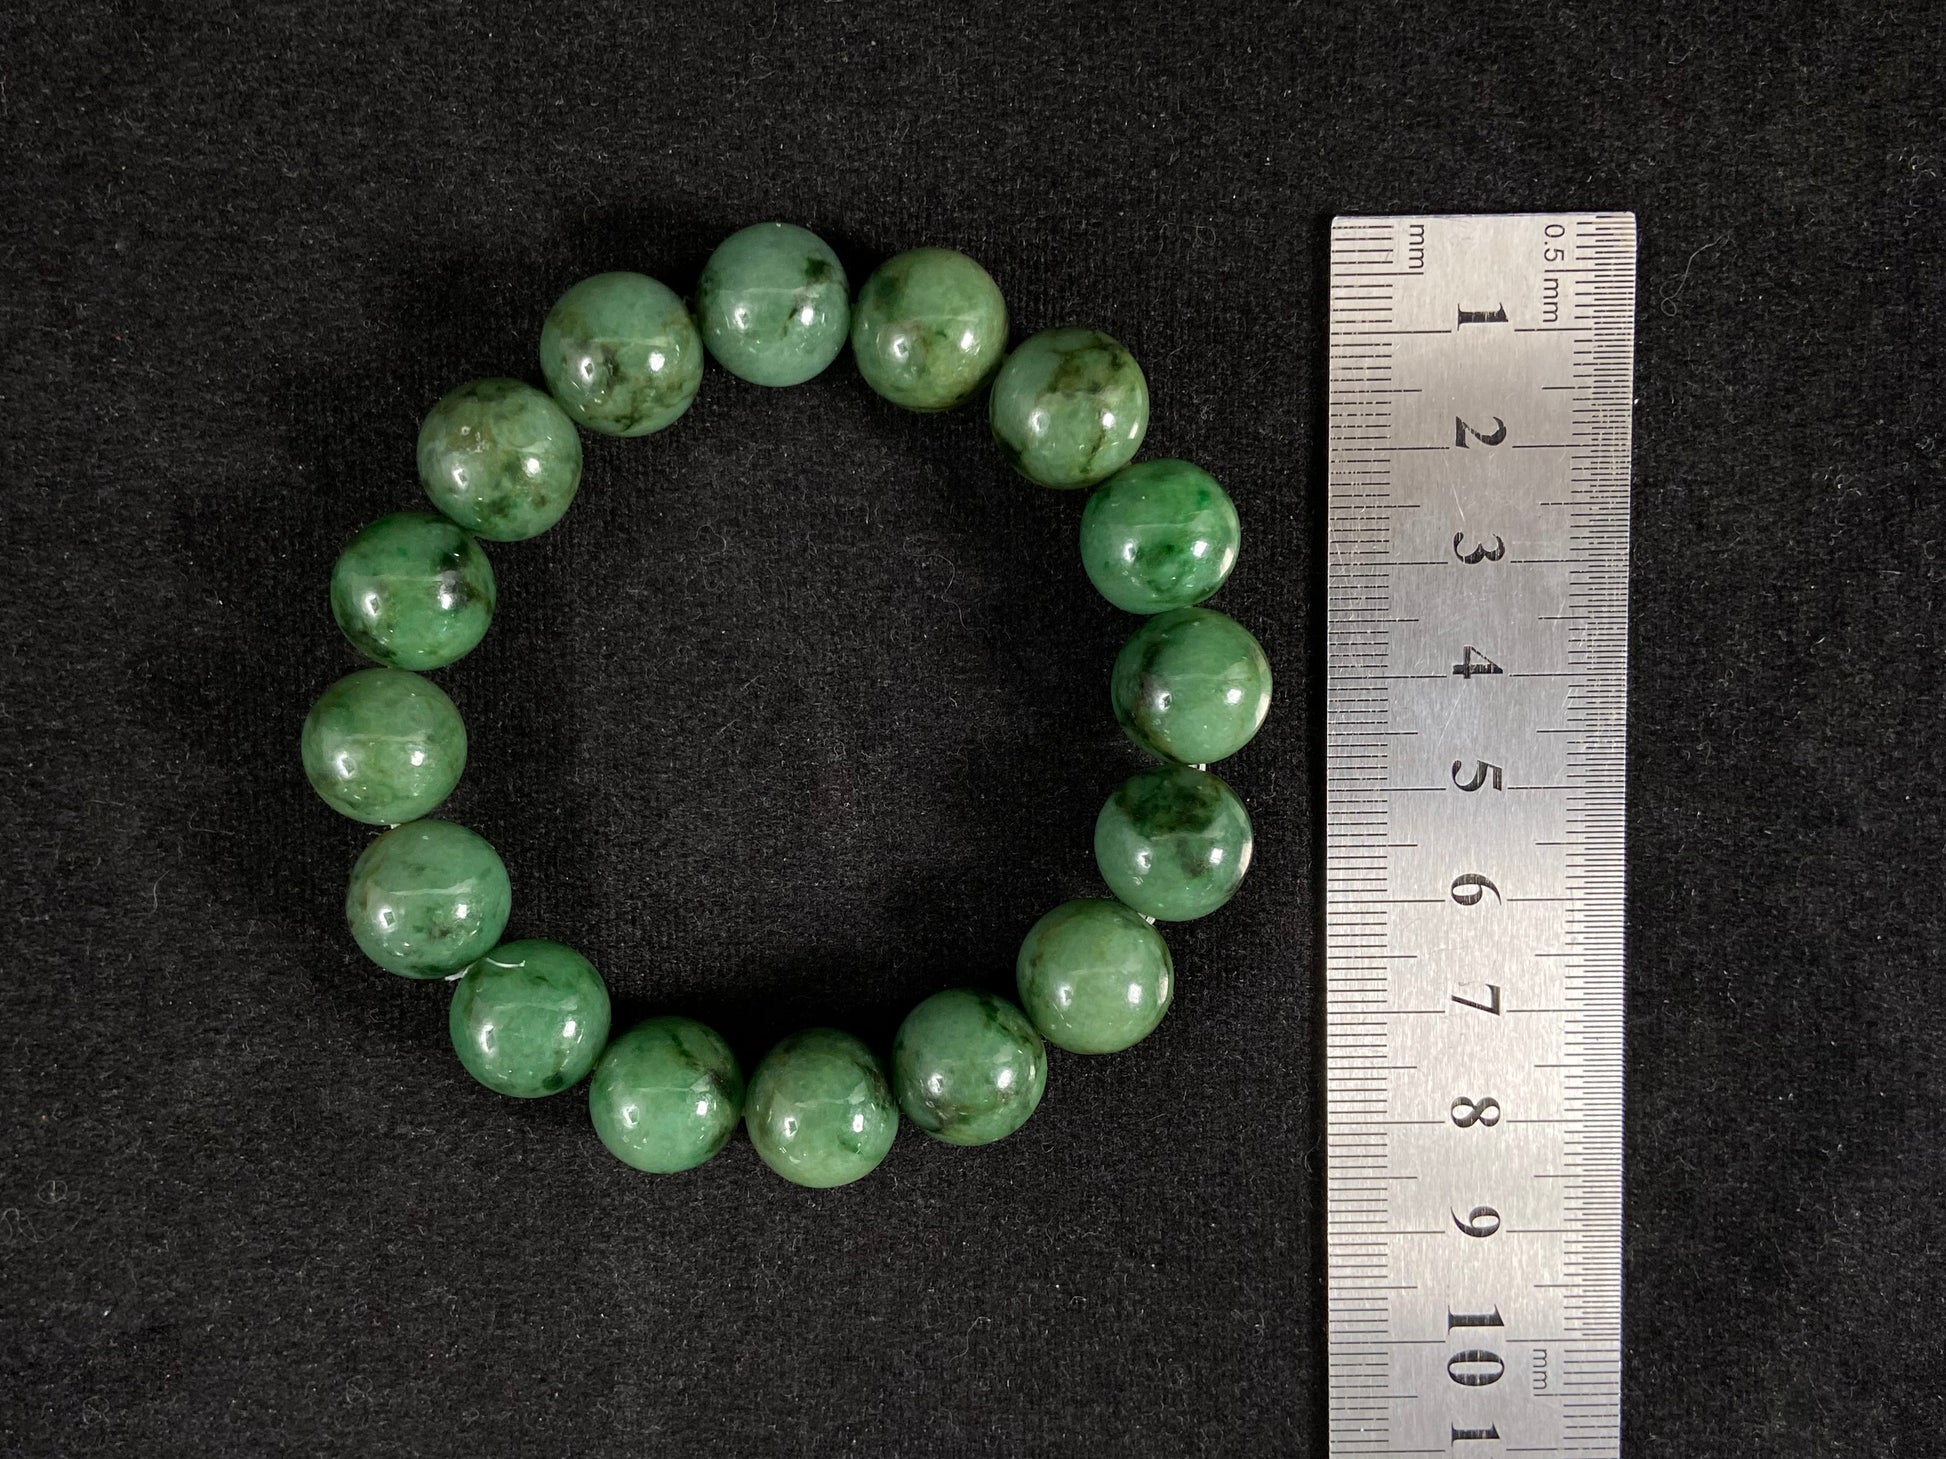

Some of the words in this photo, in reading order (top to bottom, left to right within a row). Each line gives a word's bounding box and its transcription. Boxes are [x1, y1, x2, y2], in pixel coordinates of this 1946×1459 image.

[1408, 224, 1425, 269] mm
[1543, 224, 1566, 262] 0.5
[1457, 302, 1509, 331] 1
[1542, 278, 1559, 323] mm
[1455, 416, 1507, 449] 2
[1453, 532, 1506, 565] 3
[1452, 646, 1504, 680] 4
[1451, 760, 1503, 792] 5
[1451, 873, 1502, 906] 6
[1451, 984, 1500, 1016] 7
[1451, 1097, 1501, 1129] 8
[1451, 1207, 1501, 1238] 9
[1447, 1304, 1505, 1387] 10
[1532, 1348, 1548, 1390] mm
[1451, 1421, 1501, 1459] 1
